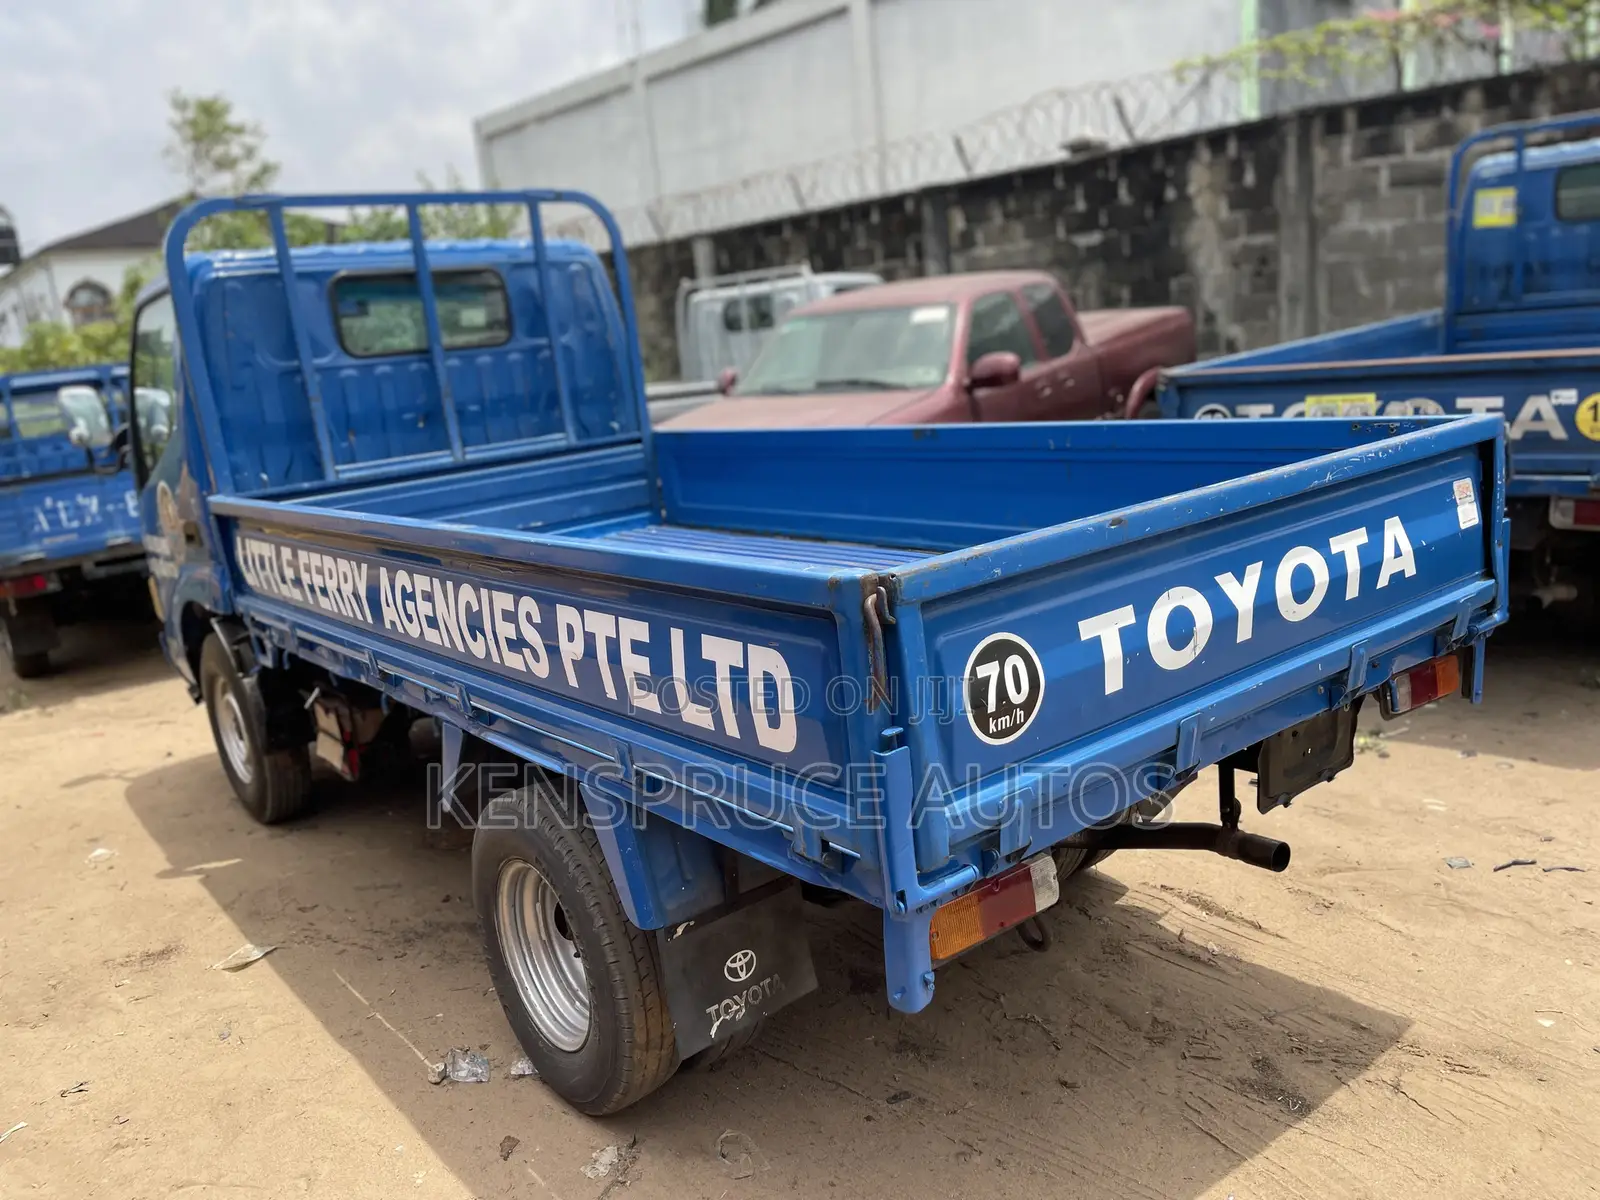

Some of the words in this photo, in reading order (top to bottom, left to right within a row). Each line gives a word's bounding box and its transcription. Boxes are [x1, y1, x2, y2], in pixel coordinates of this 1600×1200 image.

[1078, 516, 1417, 695] TOYOTA
[236, 536, 301, 599] LITTLE
[298, 550, 373, 625] FERRY
[380, 567, 549, 679] AGENCIES
[556, 604, 661, 714] PTE
[670, 627, 797, 753] LTD
[976, 654, 1029, 713] 70
[989, 708, 1024, 734] km/h
[706, 973, 786, 1024] TOYOTA
